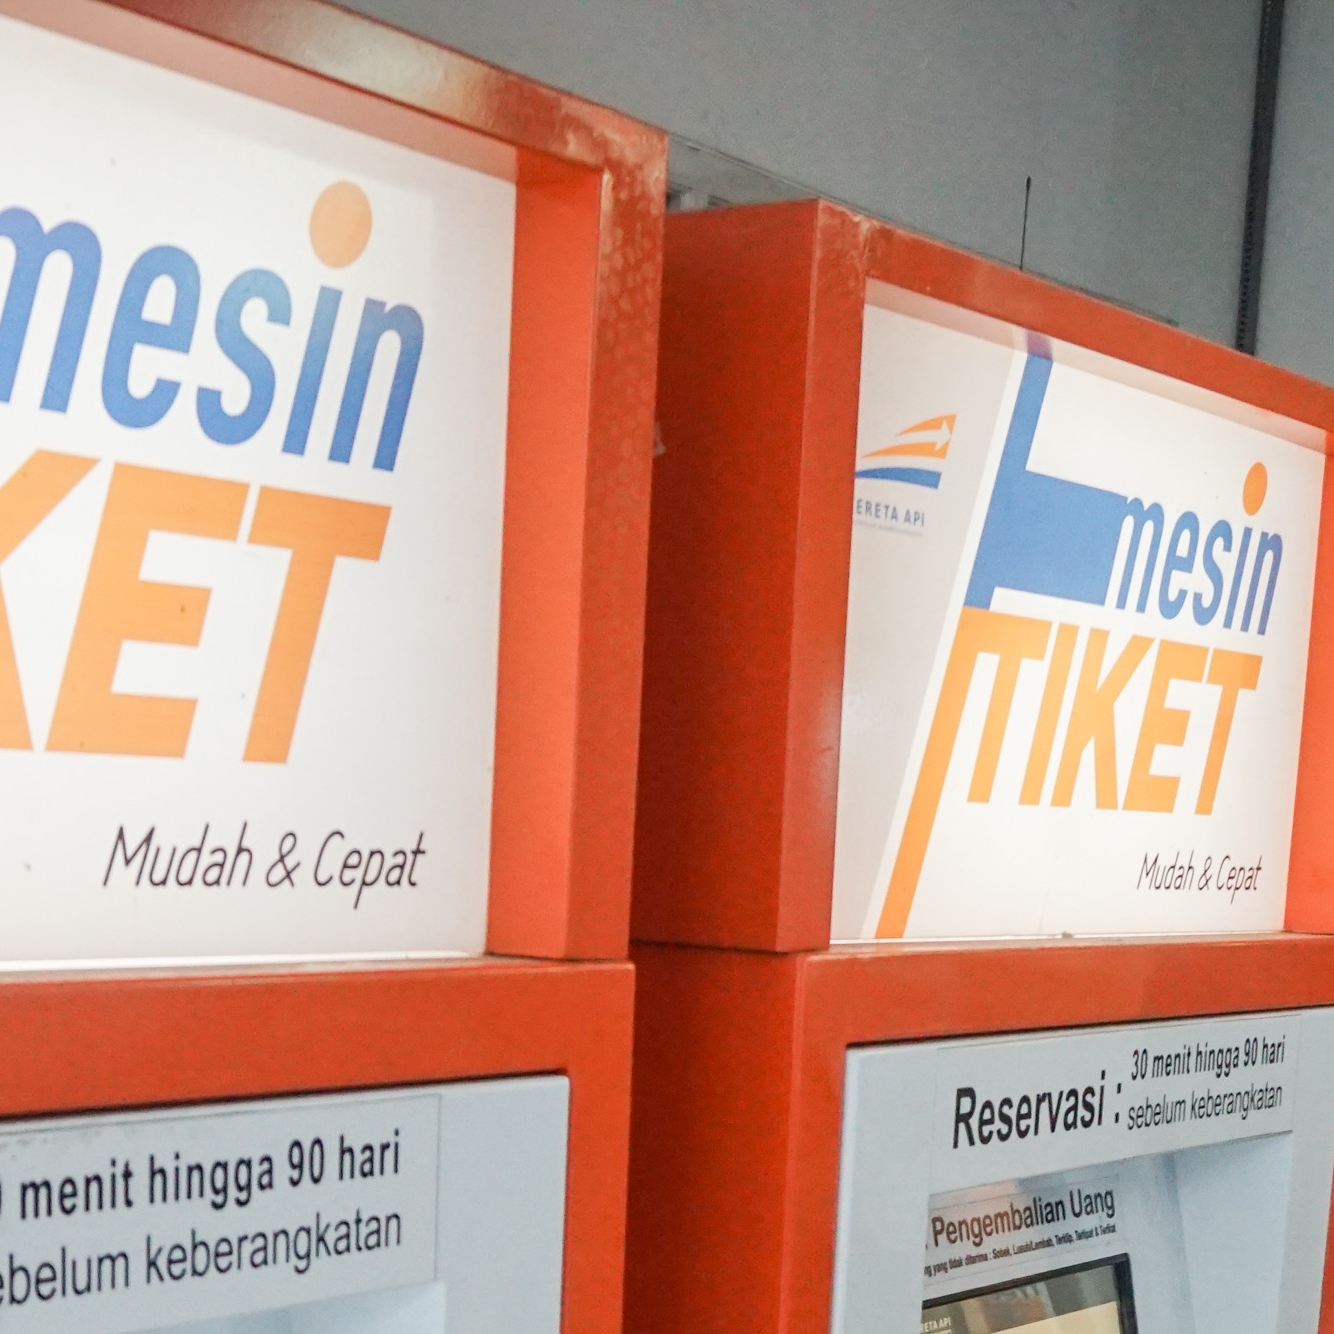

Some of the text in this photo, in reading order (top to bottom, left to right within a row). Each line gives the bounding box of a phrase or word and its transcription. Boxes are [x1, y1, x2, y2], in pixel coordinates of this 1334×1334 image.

[856, 499, 925, 527] ERETA API
[1107, 461, 1284, 636] mesin
[961, 605, 1264, 816] TIKET
[103, 822, 425, 908] Mudah & Cepat
[1137, 850, 1263, 905] Mudah & Cepat
[1131, 1034, 1286, 1081] 30 menit hingga 90 hari
[953, 1070, 1106, 1149] Reservasi
[1127, 1082, 1283, 1131] sebelum keberangkatan
[20, 1158, 134, 1221] menit
[147, 1150, 274, 1211] hingga
[287, 1137, 325, 1187] 90
[338, 1128, 401, 1182] hari
[145, 1206, 403, 1286] keberangkatan
[931, 1187, 1115, 1248] Pengembalian Uang
